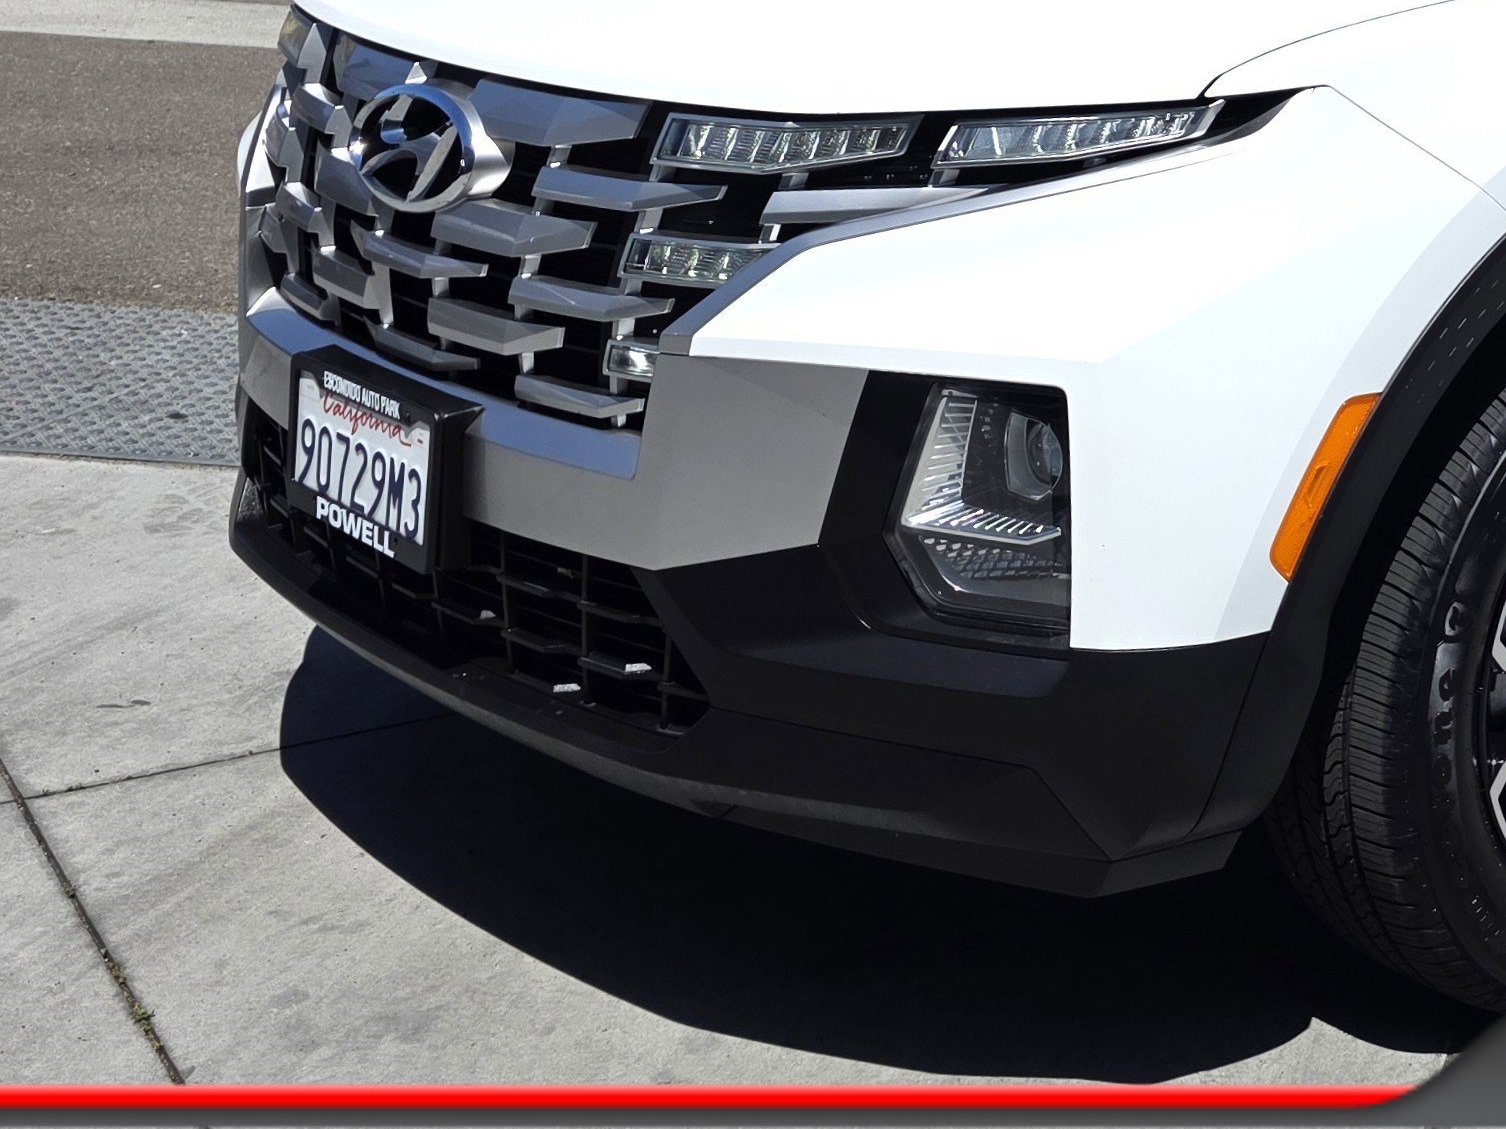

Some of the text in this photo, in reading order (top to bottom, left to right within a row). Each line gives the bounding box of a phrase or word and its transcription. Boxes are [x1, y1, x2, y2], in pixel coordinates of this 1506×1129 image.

[322, 390, 412, 447] California
[361, 387, 381, 411] AUTO
[380, 395, 401, 420] PARK
[299, 419, 421, 540] 90729M3
[316, 496, 396, 559] POWELL
